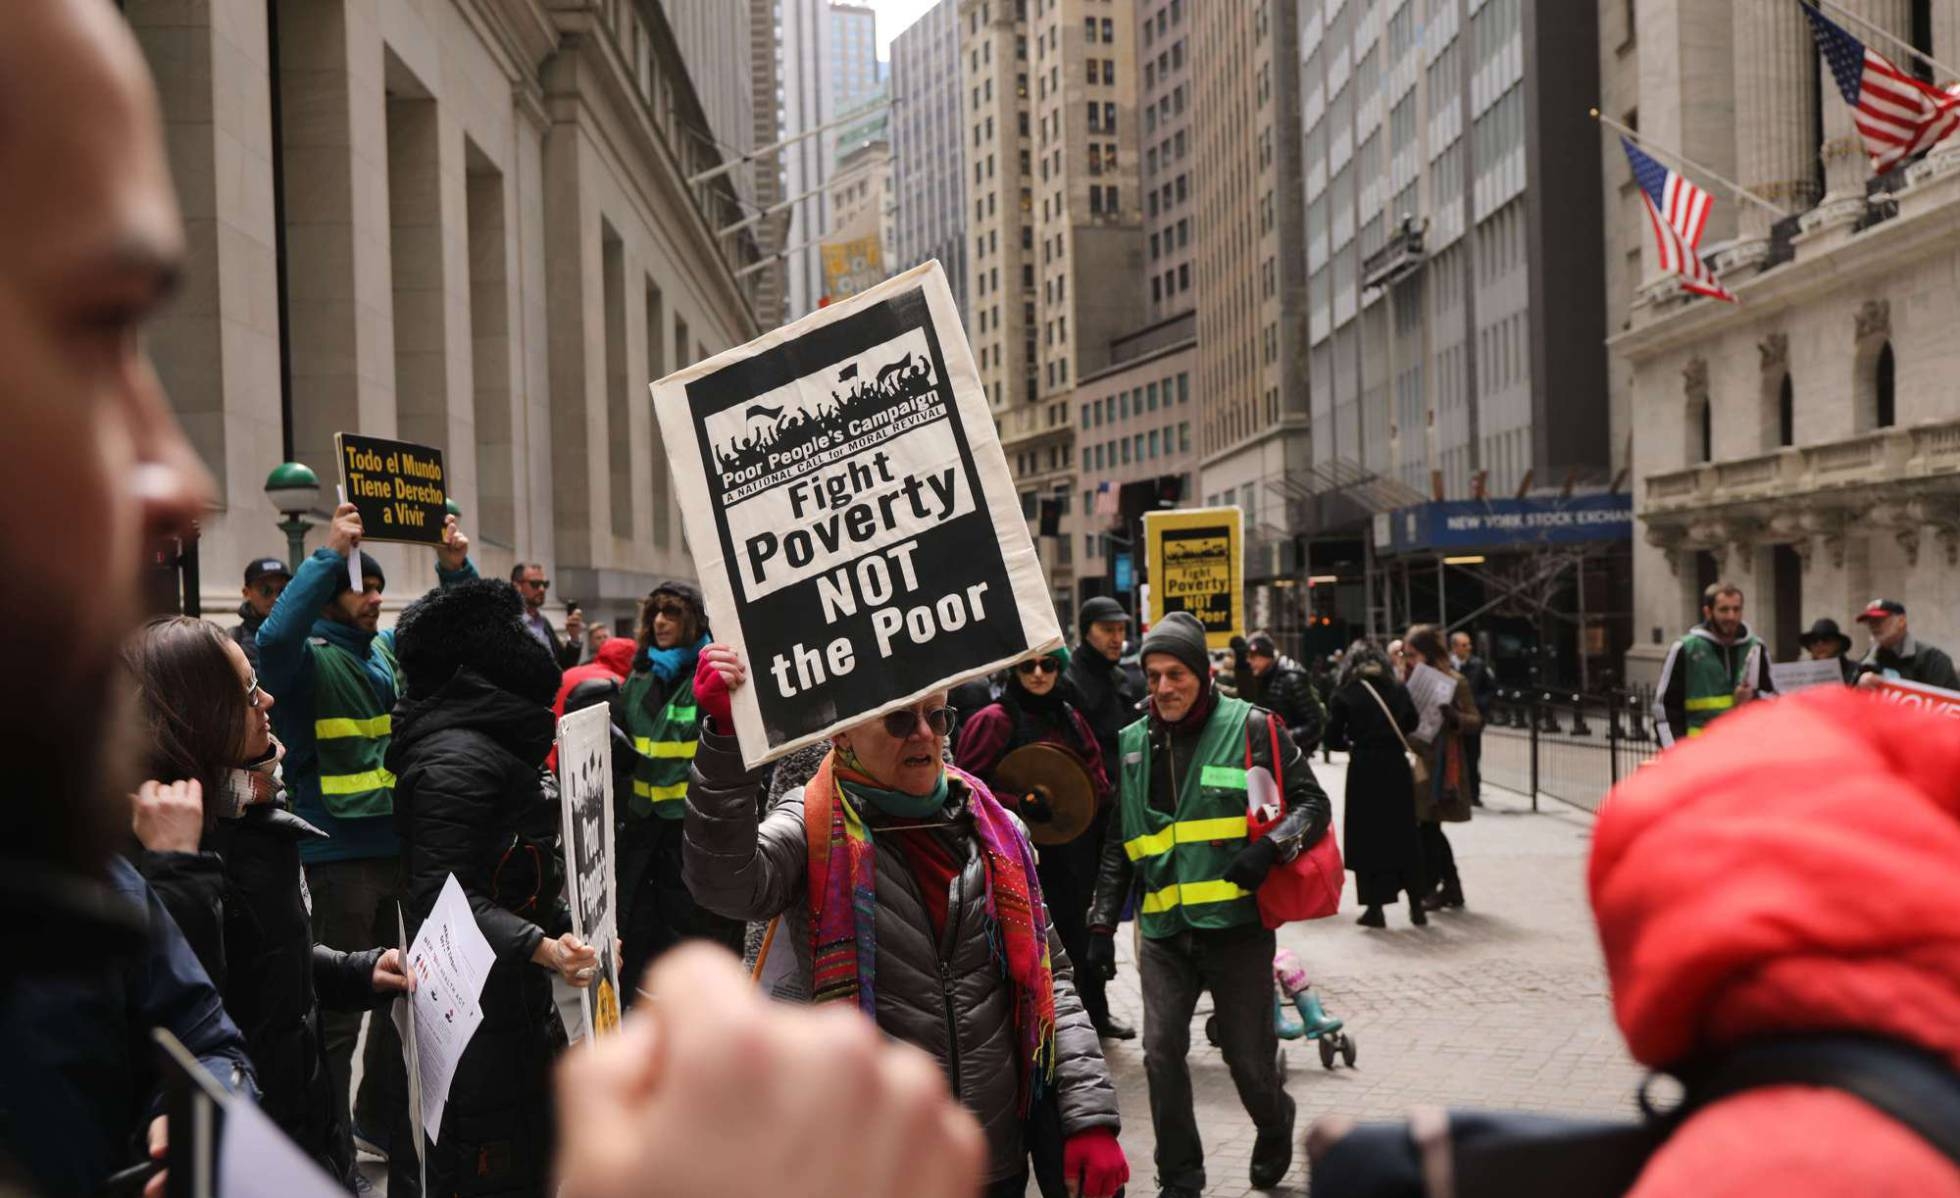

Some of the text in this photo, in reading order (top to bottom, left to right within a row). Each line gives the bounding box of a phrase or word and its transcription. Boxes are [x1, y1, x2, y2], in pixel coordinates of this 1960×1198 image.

[722, 389, 940, 489] Poor People's Campaign
[726, 406, 941, 502] A NATIONAL CALL for MORAL REVIVAL
[346, 446, 442, 480] Todo el Mundo
[350, 472, 443, 505] Tiene Derecho
[788, 451, 895, 520] Fight
[383, 503, 425, 527] a Vivir
[745, 467, 955, 585] Poverty
[1447, 516, 1480, 530] NEW
[1484, 513, 1523, 529] YORK
[1526, 511, 1573, 528] STOCK
[816, 539, 919, 625] NOT
[1168, 577, 1226, 593] Poverty
[1182, 567, 1211, 579] Fight
[1184, 594, 1212, 609] NOT
[1196, 610, 1227, 623] Poor
[770, 581, 989, 698] the Poor
